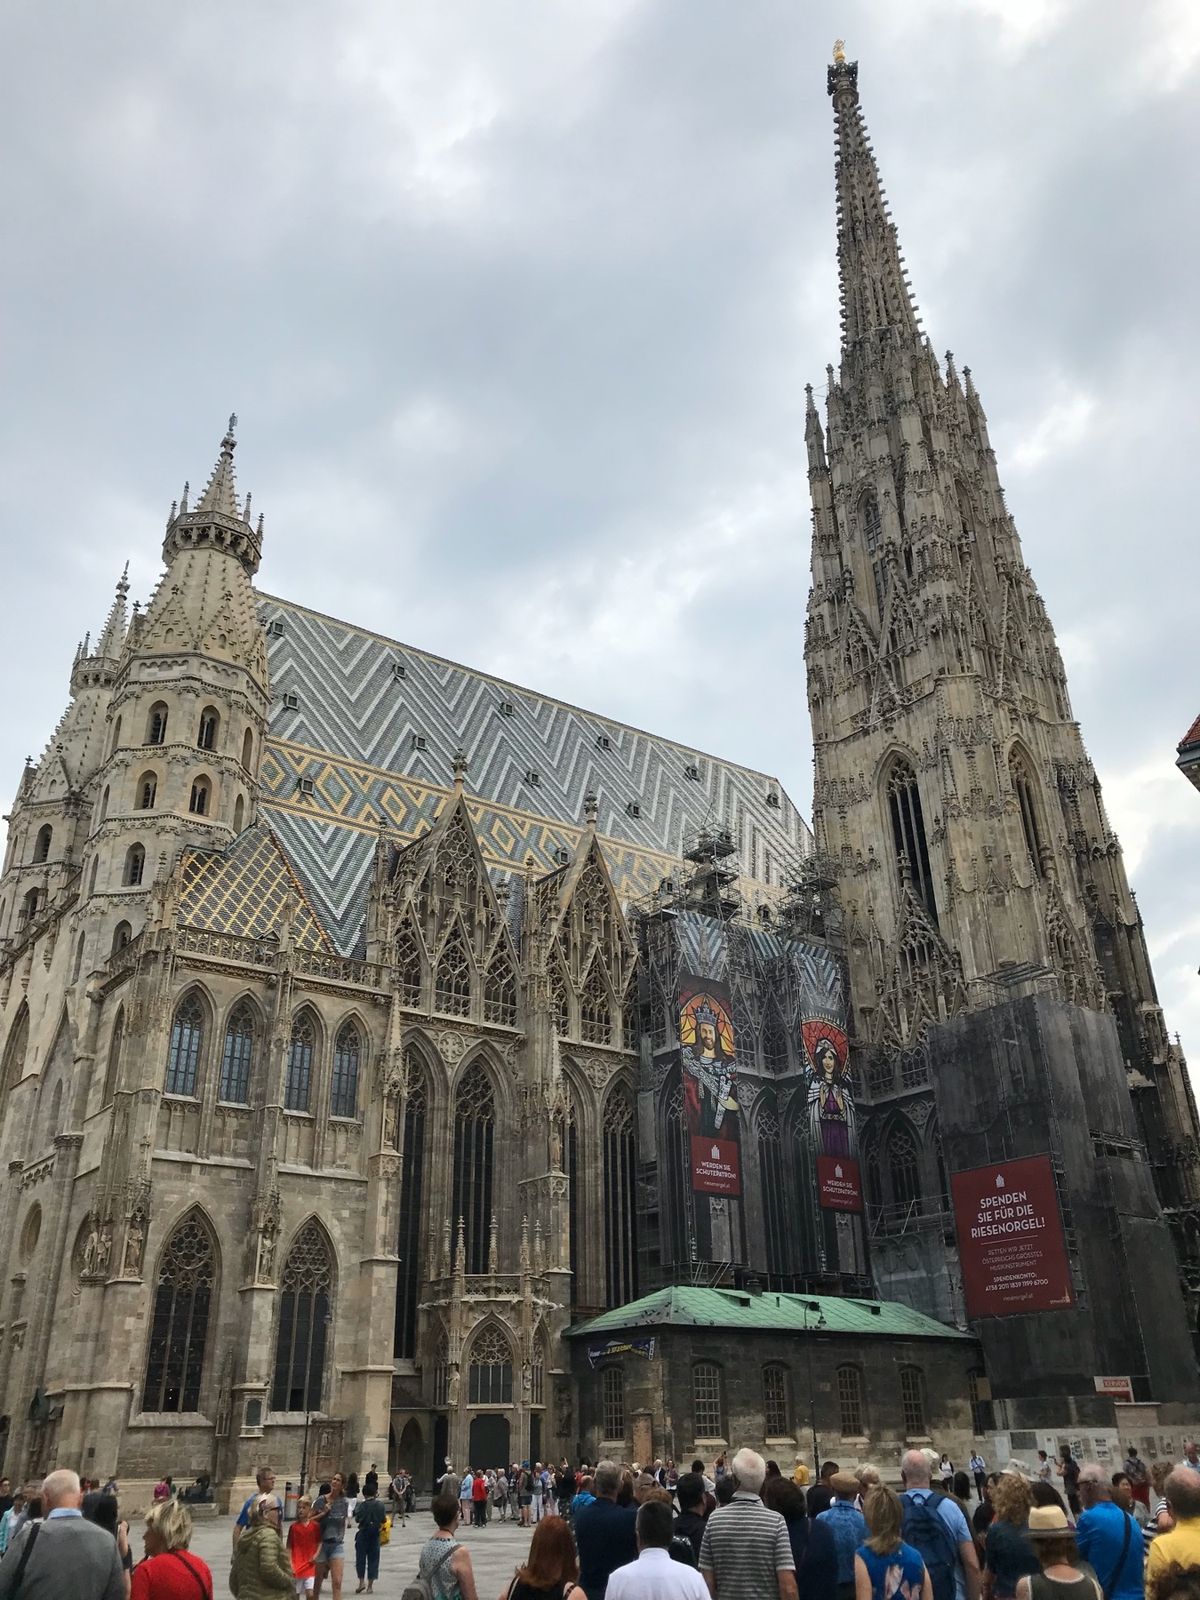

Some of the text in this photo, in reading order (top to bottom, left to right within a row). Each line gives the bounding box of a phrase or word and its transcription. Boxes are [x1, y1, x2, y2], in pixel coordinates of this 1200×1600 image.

[701, 1161, 723, 1169] WERDEN
[980, 1191, 1027, 1209] SPENDEN
[977, 1204, 1034, 1223] SIE FÜR DIE
[971, 1217, 1046, 1239] RIESENORGEL!
[1018, 1243, 1034, 1252] JETZT
